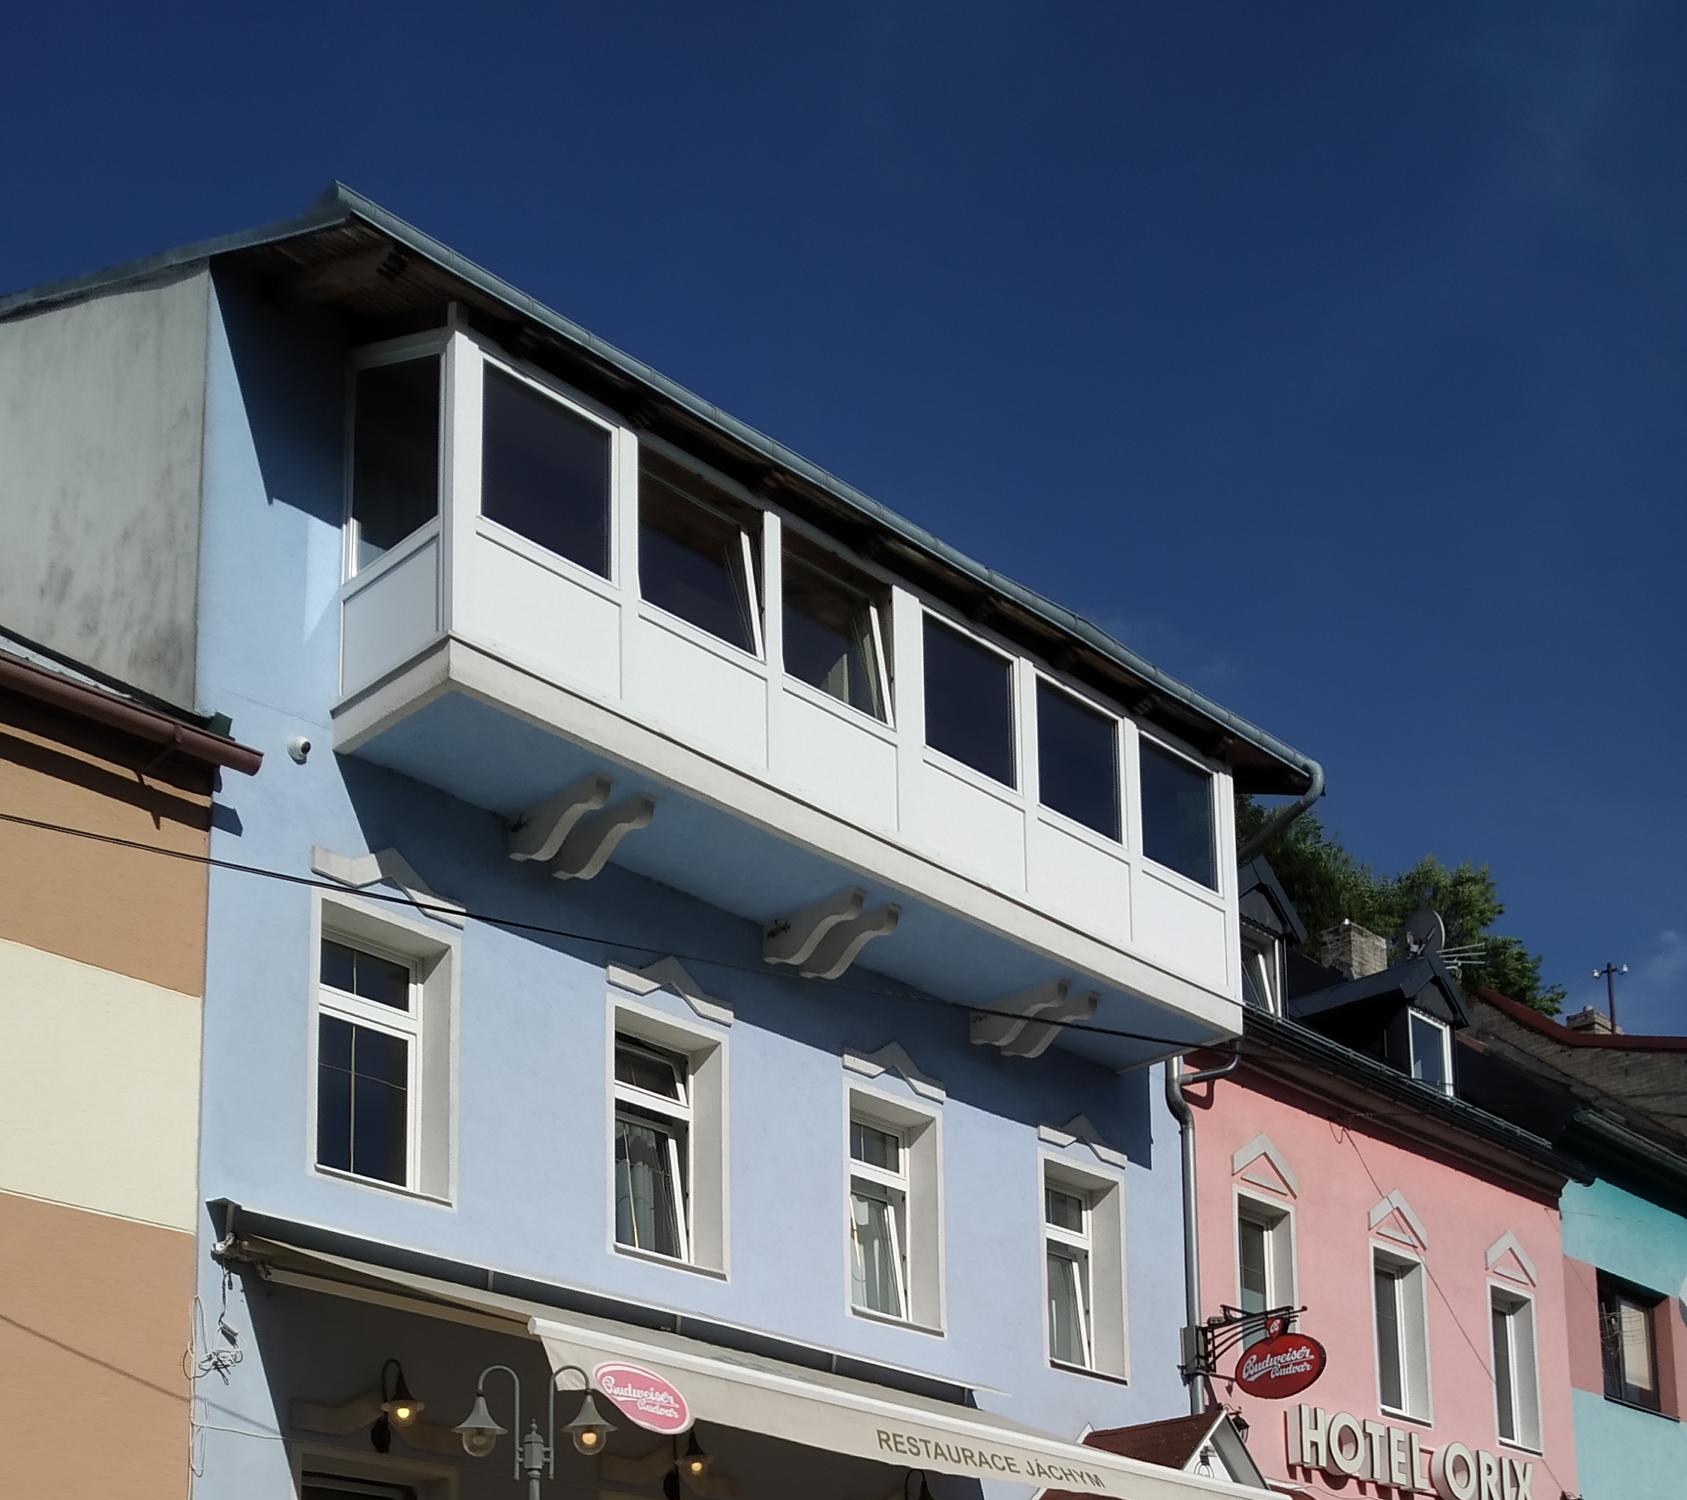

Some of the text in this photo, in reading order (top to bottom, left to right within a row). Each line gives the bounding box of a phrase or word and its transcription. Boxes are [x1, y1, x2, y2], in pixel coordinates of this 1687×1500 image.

[1242, 1346, 1315, 1381] Budweiser
[1270, 1362, 1313, 1379] Budvar
[602, 1376, 679, 1408] Budweiser
[876, 1429, 1106, 1489] RESTAURACE JÁCHYM
[1288, 1403, 1429, 1492] HOTEL
